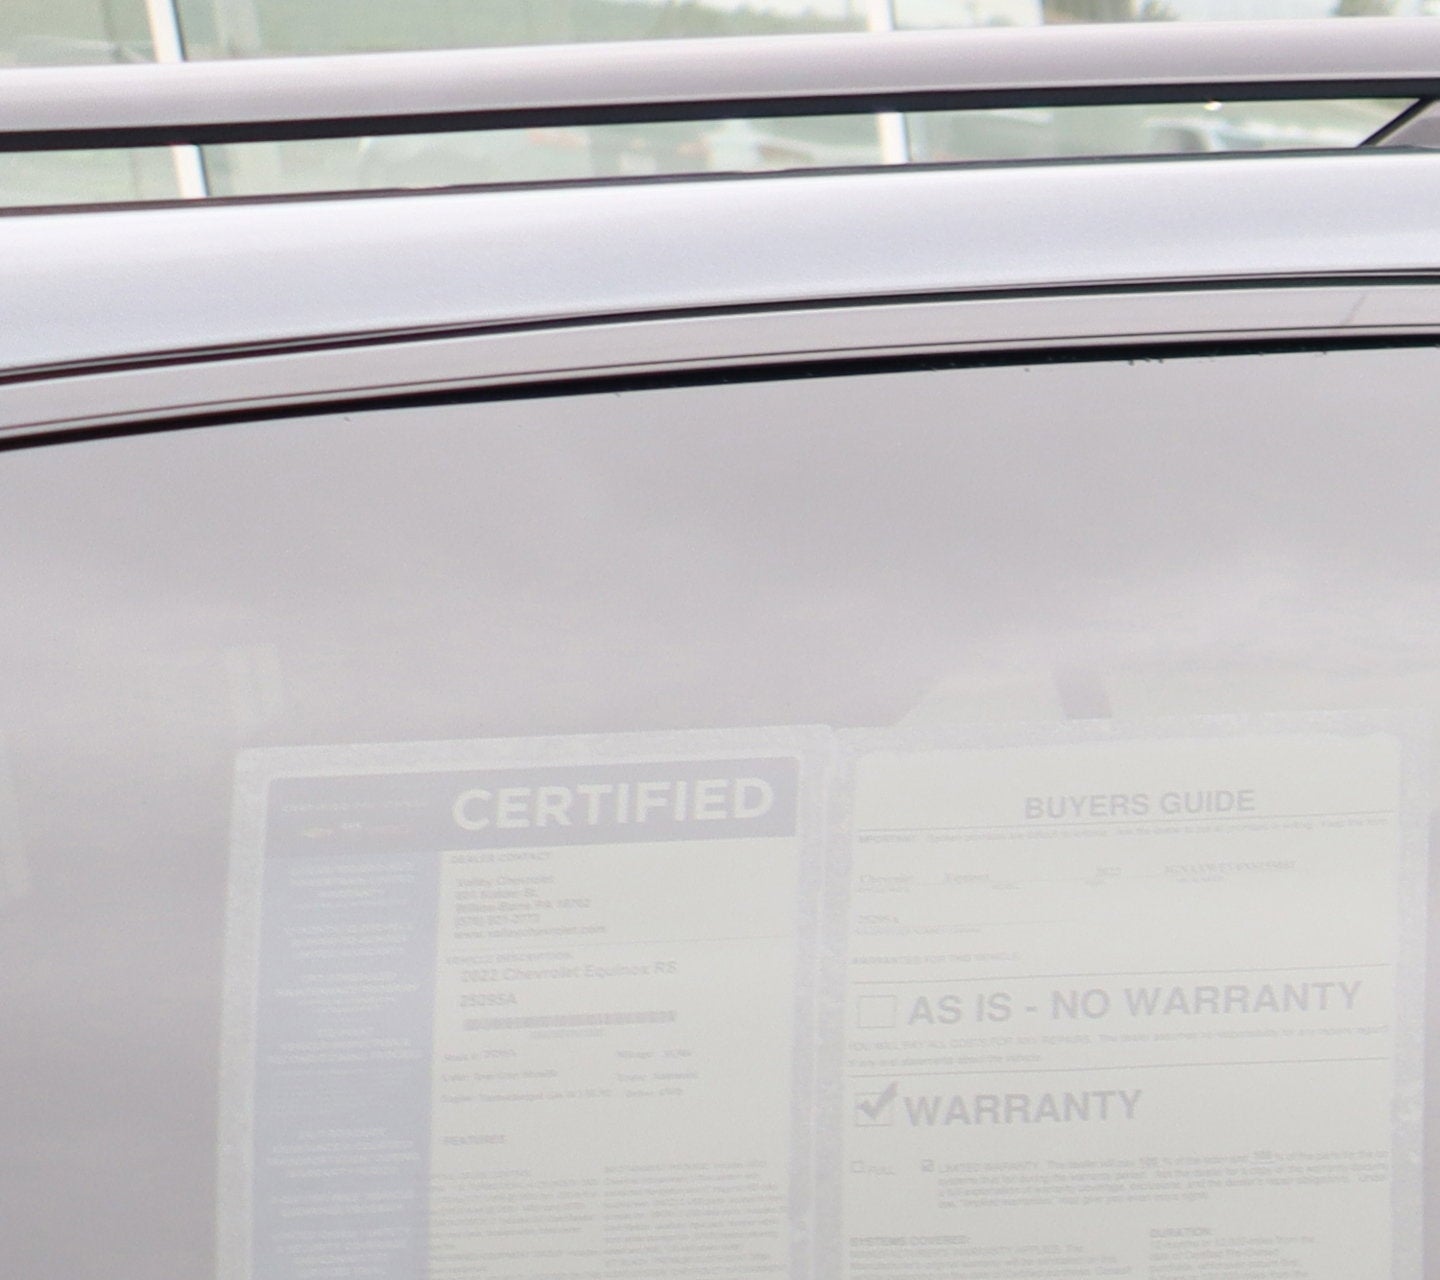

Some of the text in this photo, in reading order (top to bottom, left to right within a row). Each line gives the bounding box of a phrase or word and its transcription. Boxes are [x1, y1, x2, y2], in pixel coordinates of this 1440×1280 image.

[452, 776, 775, 831] CERTIFIED
[1024, 789, 1256, 820] BUYERS GUIDE
[461, 968, 500, 983] 2022
[502, 965, 582, 980] Chevrolet
[584, 963, 651, 980] Equinox
[907, 995, 964, 1026] AS
[976, 991, 1013, 1023] IS
[1050, 988, 1111, 1021] NO
[1124, 980, 1363, 1017] WARRANTY
[904, 1089, 1143, 1126] WARRANTY
